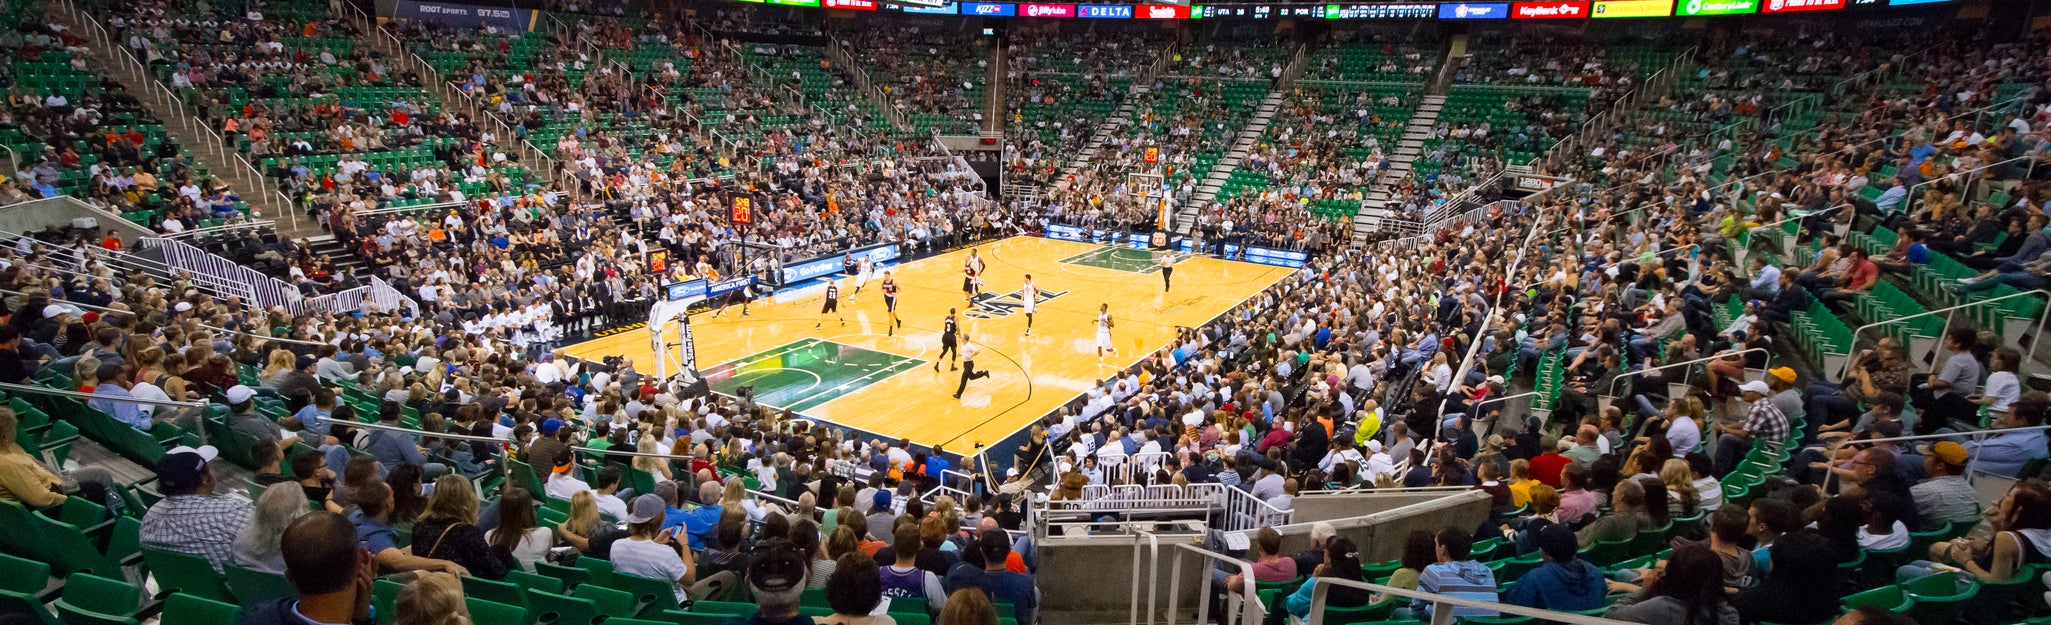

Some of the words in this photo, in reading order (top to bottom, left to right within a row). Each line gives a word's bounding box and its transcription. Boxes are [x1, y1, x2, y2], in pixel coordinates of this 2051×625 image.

[420, 5, 442, 13] ROOT
[442, 8, 468, 16] SPORTS
[975, 5, 993, 14] KJZZ
[1519, 6, 1559, 17] KeyBank
[1702, 1, 1753, 11] CenturyLink
[477, 9, 501, 18] 97.5
[1090, 8, 1131, 17] DELTA
[1519, 177, 1542, 188] 1280
[734, 206, 749, 222] 20
[799, 267, 810, 279] Go
[810, 262, 833, 276] Further
[710, 281, 736, 293] AMERICA
[736, 278, 752, 289] FIRST
[946, 323, 951, 332] 3
[1087, 441, 1096, 452] 12
[1357, 457, 1370, 472] 15
